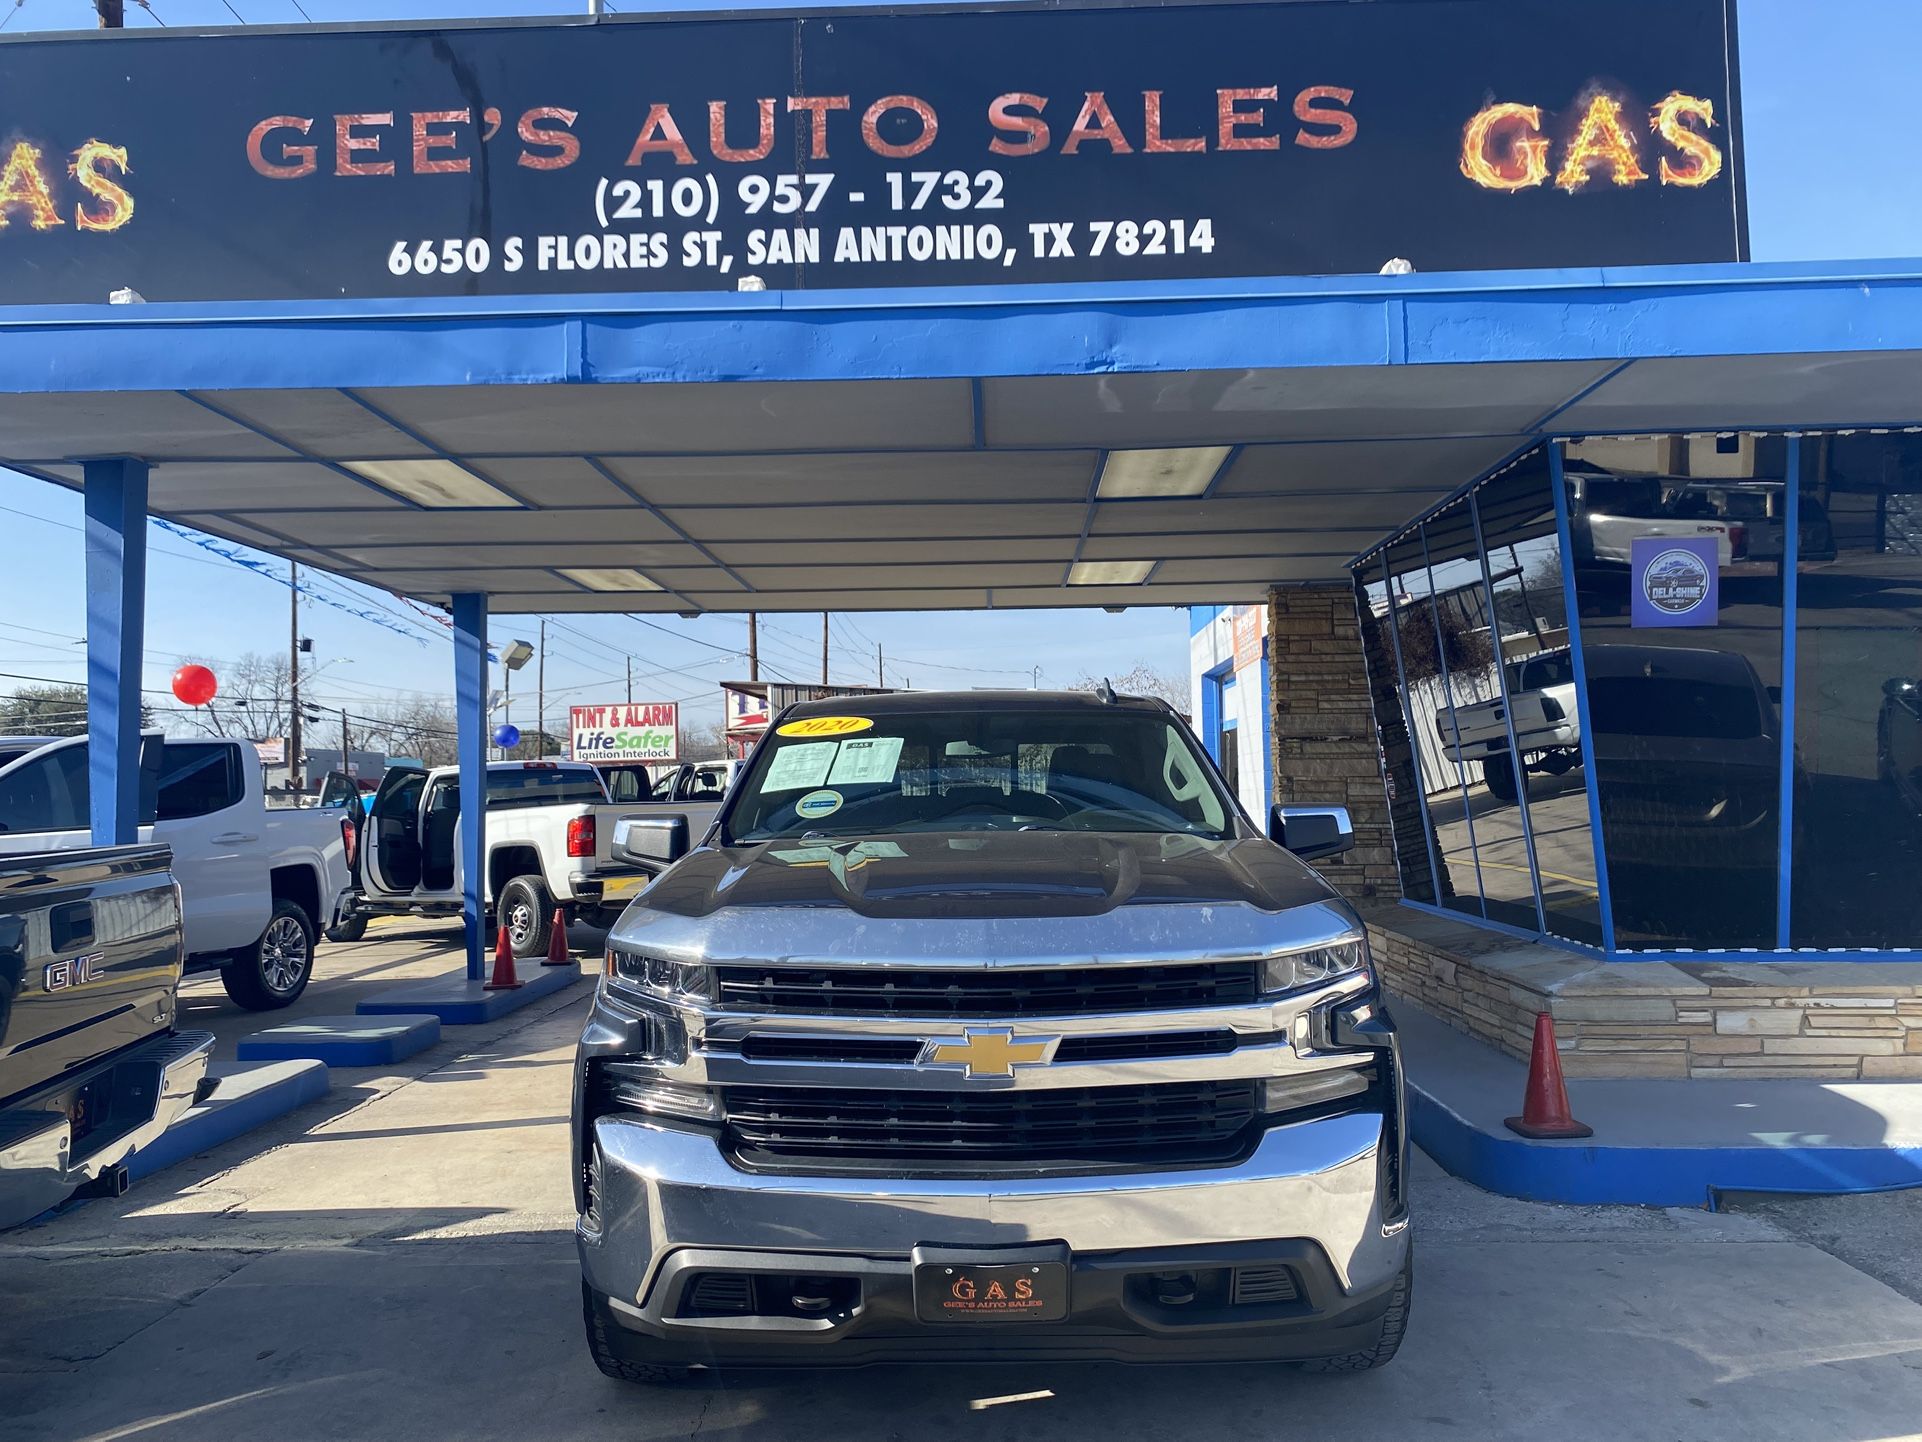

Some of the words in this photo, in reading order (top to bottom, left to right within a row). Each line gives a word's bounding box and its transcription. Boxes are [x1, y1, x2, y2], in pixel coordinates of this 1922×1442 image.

[246, 104, 581, 180] GEE'S
[625, 94, 939, 167] AUTO
[987, 85, 1358, 158] SALES
[1459, 90, 1723, 194] GAS
[595, 171, 720, 228] (210)
[738, 174, 835, 214] 957
[848, 190, 865, 202] -
[885, 170, 1005, 211] 1732
[388, 238, 491, 275] 6650
[503, 237, 524, 272] S
[538, 232, 668, 271] FLORES
[682, 230, 733, 274] ST,
[747, 227, 820, 265] SAN
[834, 222, 1016, 267] ANTONIO,
[1029, 222, 1075, 258] TX
[1088, 218, 1215, 257] 78214
[572, 707, 606, 729] TINT
[609, 706, 620, 728] &
[623, 705, 674, 727] ALARM
[789, 719, 859, 734] 2020
[576, 730, 674, 750] LifeSafer
[578, 750, 620, 760] Ignition
[622, 748, 670, 759] Interlock
[46, 951, 104, 992] GMC
[152, 1012, 167, 1024] SLT
